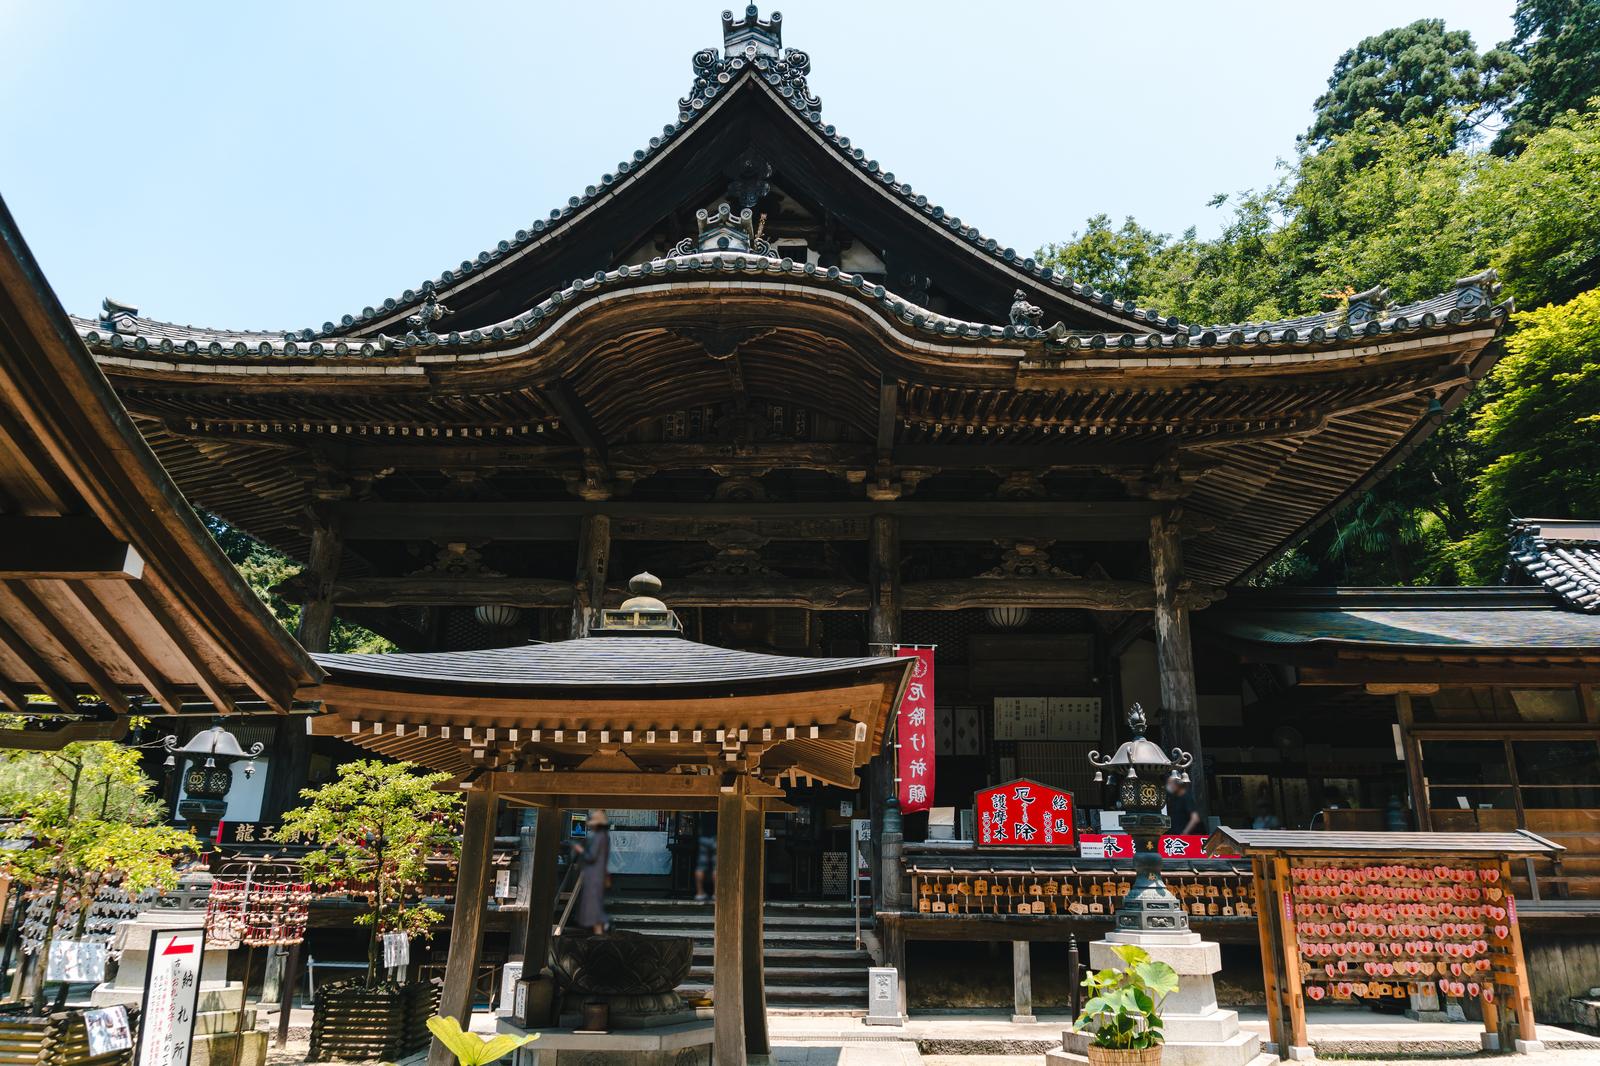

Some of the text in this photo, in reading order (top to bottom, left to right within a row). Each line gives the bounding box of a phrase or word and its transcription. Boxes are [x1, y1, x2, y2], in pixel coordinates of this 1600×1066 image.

[991, 794, 1008, 841] 護摩木
[1052, 795, 1068, 834] 絵馬
[172, 970, 194, 1060] 納札所
